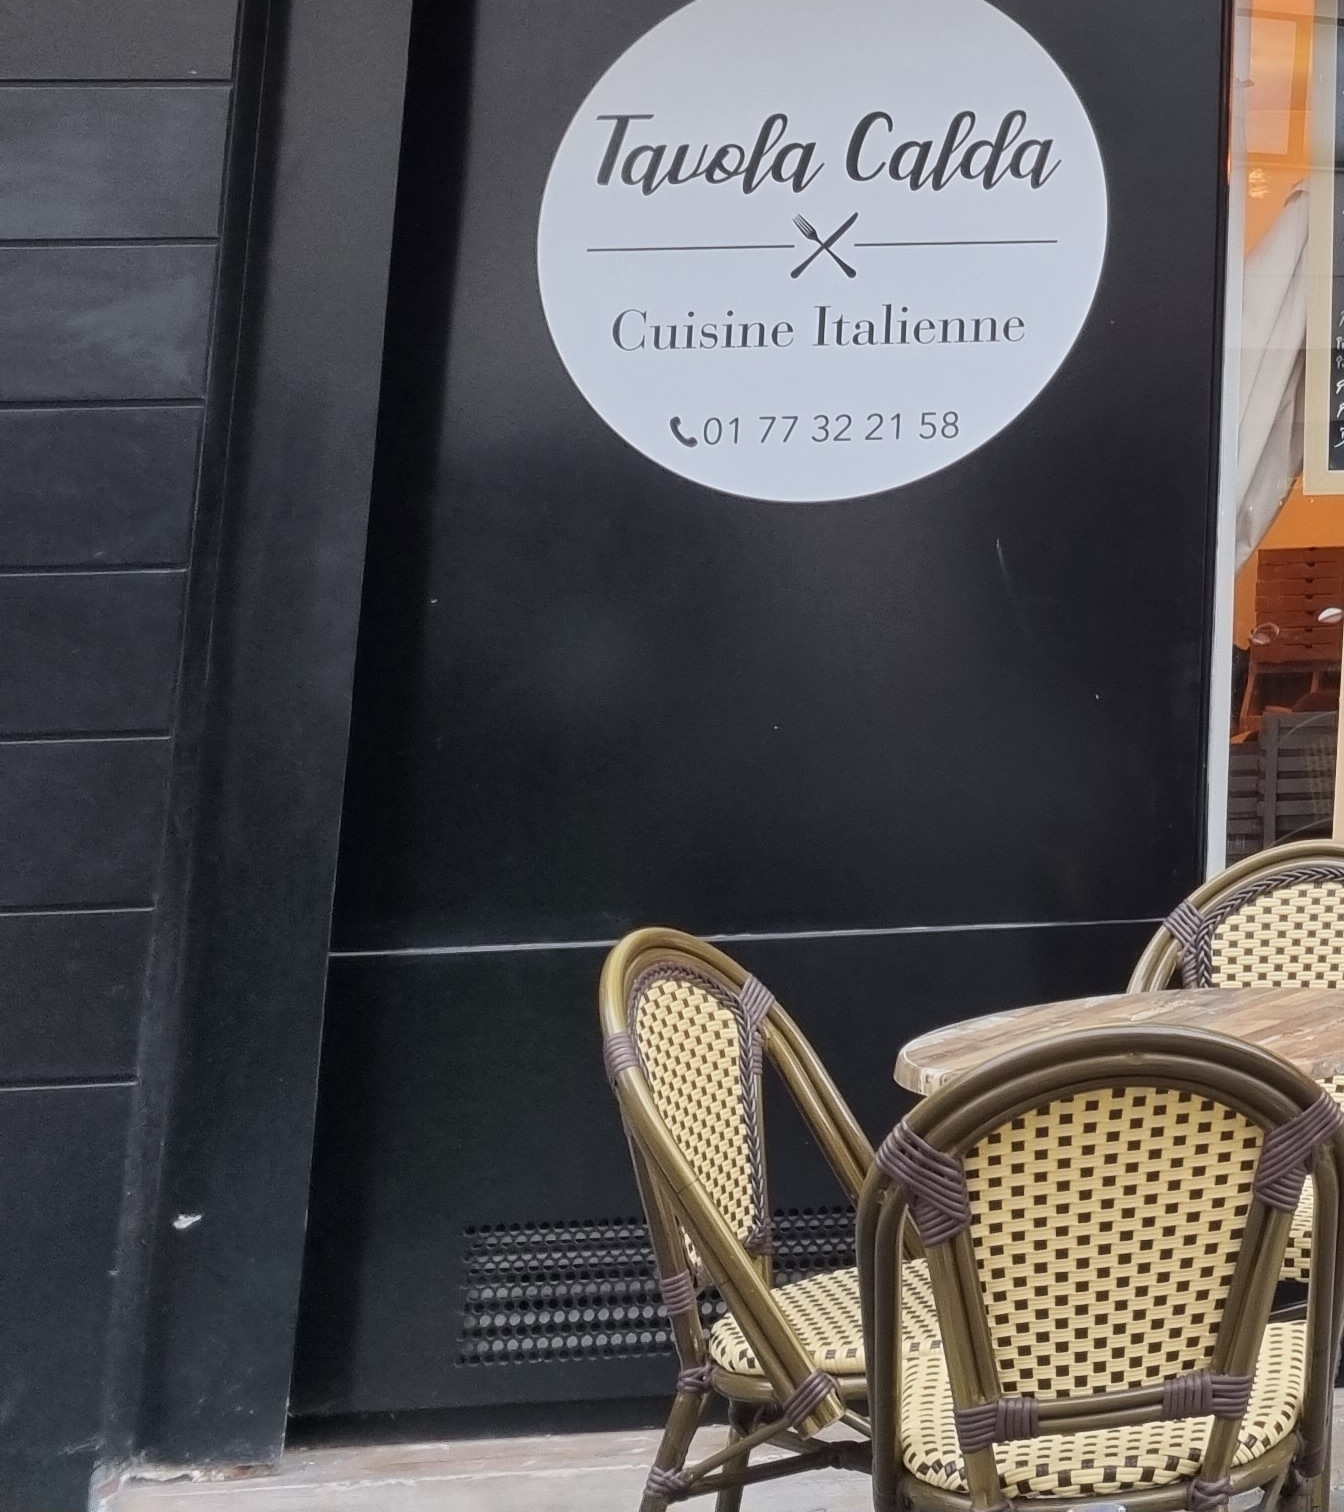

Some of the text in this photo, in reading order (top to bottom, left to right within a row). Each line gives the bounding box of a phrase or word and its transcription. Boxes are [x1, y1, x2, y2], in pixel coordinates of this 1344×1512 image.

[596, 109, 1062, 196] Tavola Calda
[611, 304, 1026, 351] Cuisine Italienne
[703, 411, 960, 446] 01 77 32 21 58
